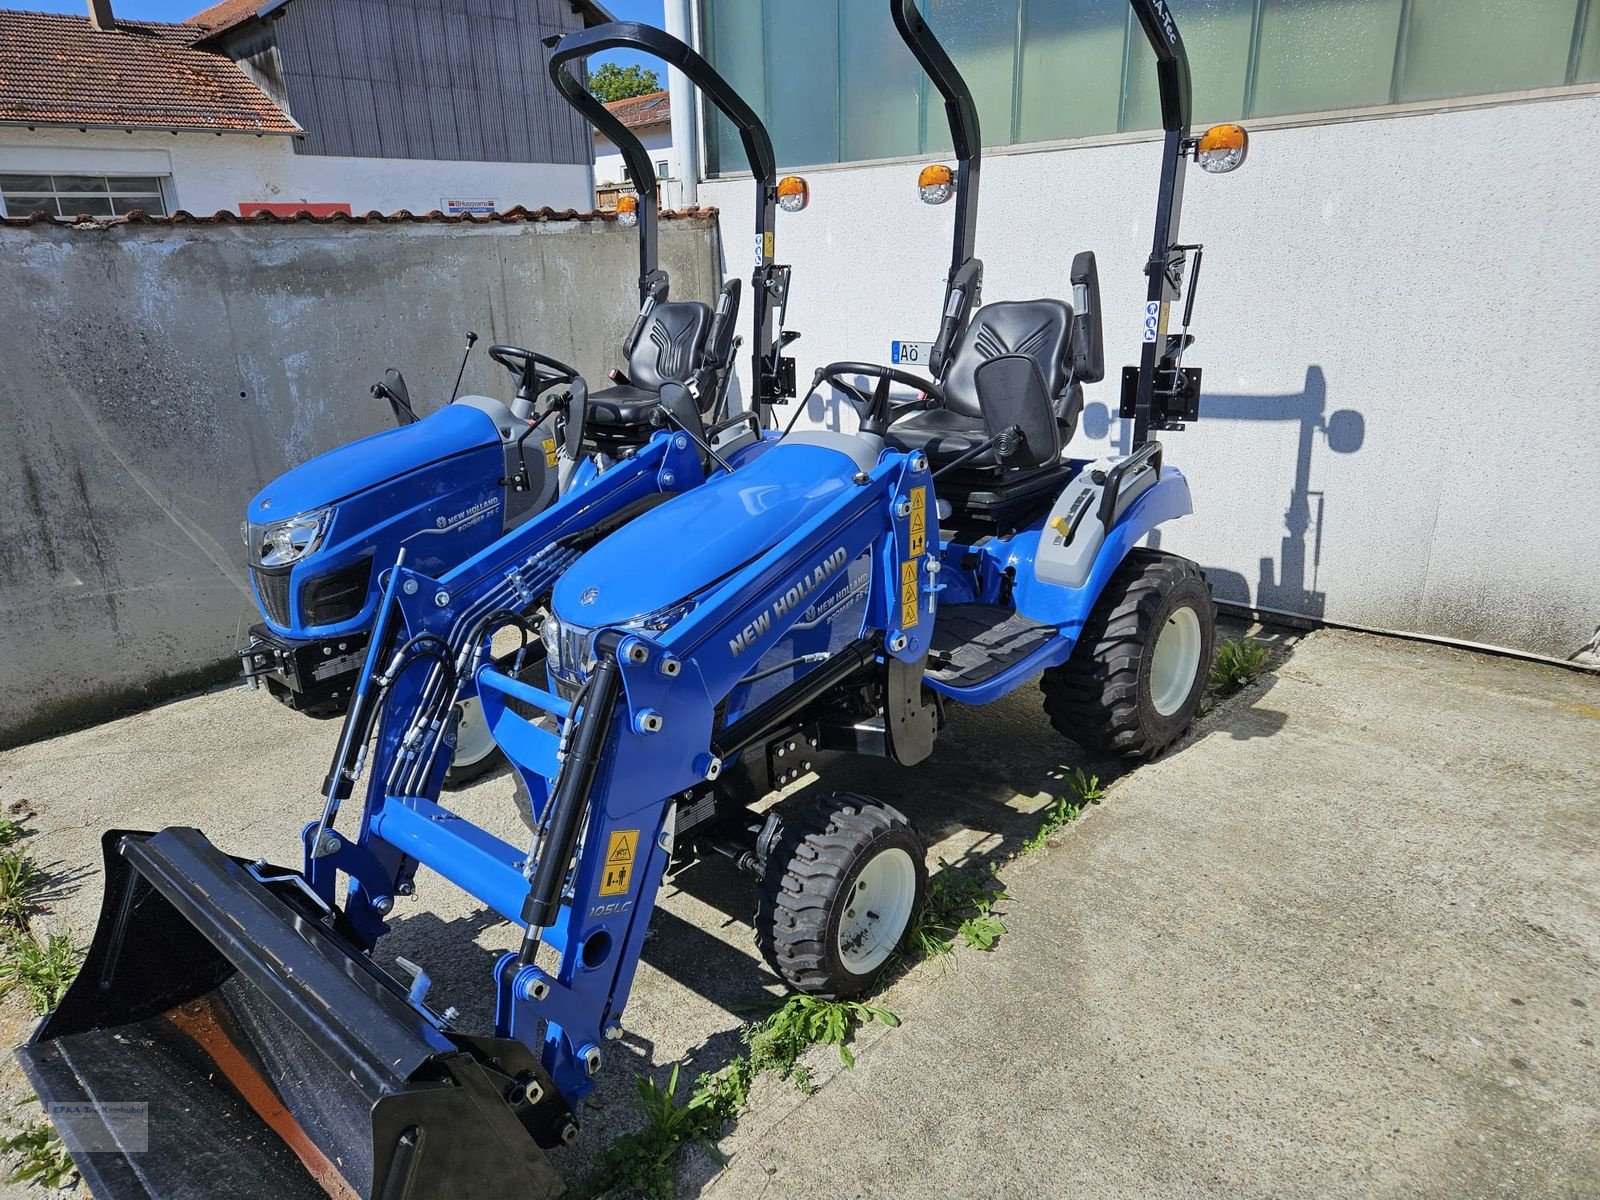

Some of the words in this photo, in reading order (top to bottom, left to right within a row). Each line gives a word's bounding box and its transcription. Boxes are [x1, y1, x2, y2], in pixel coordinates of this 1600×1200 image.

[900, 344, 918, 361] AÖ
[447, 511, 465, 524] NEW
[466, 496, 498, 516] HOLLAND
[457, 514, 484, 532] BOOMER
[728, 610, 770, 657] NEW
[773, 546, 847, 620] HOLLAND
[817, 595, 836, 616] NEW
[835, 572, 868, 600] HOLLAND
[826, 600, 854, 624] BOOMER
